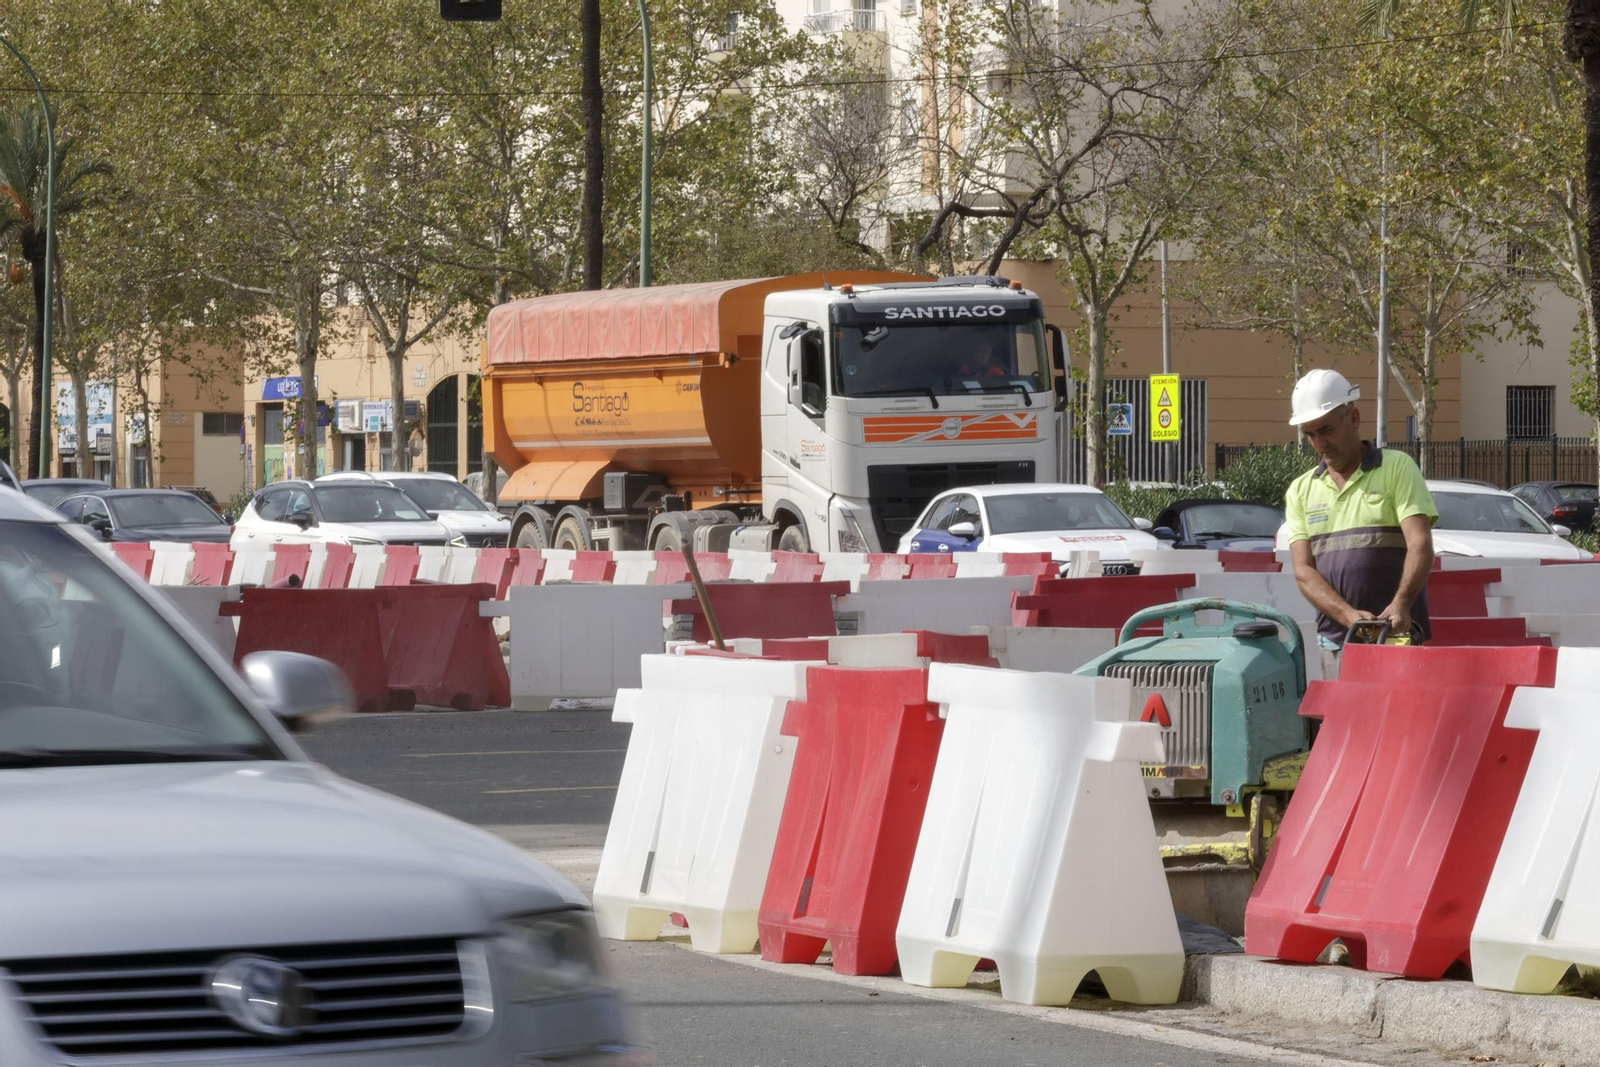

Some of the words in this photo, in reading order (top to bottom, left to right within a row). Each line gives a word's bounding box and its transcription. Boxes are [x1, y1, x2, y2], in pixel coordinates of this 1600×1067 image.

[884, 305, 1006, 319] SANTIAGO
[573, 382, 629, 417] Santiago
[1153, 430, 1178, 438] COLEGIO
[1253, 685, 1267, 703] 21
